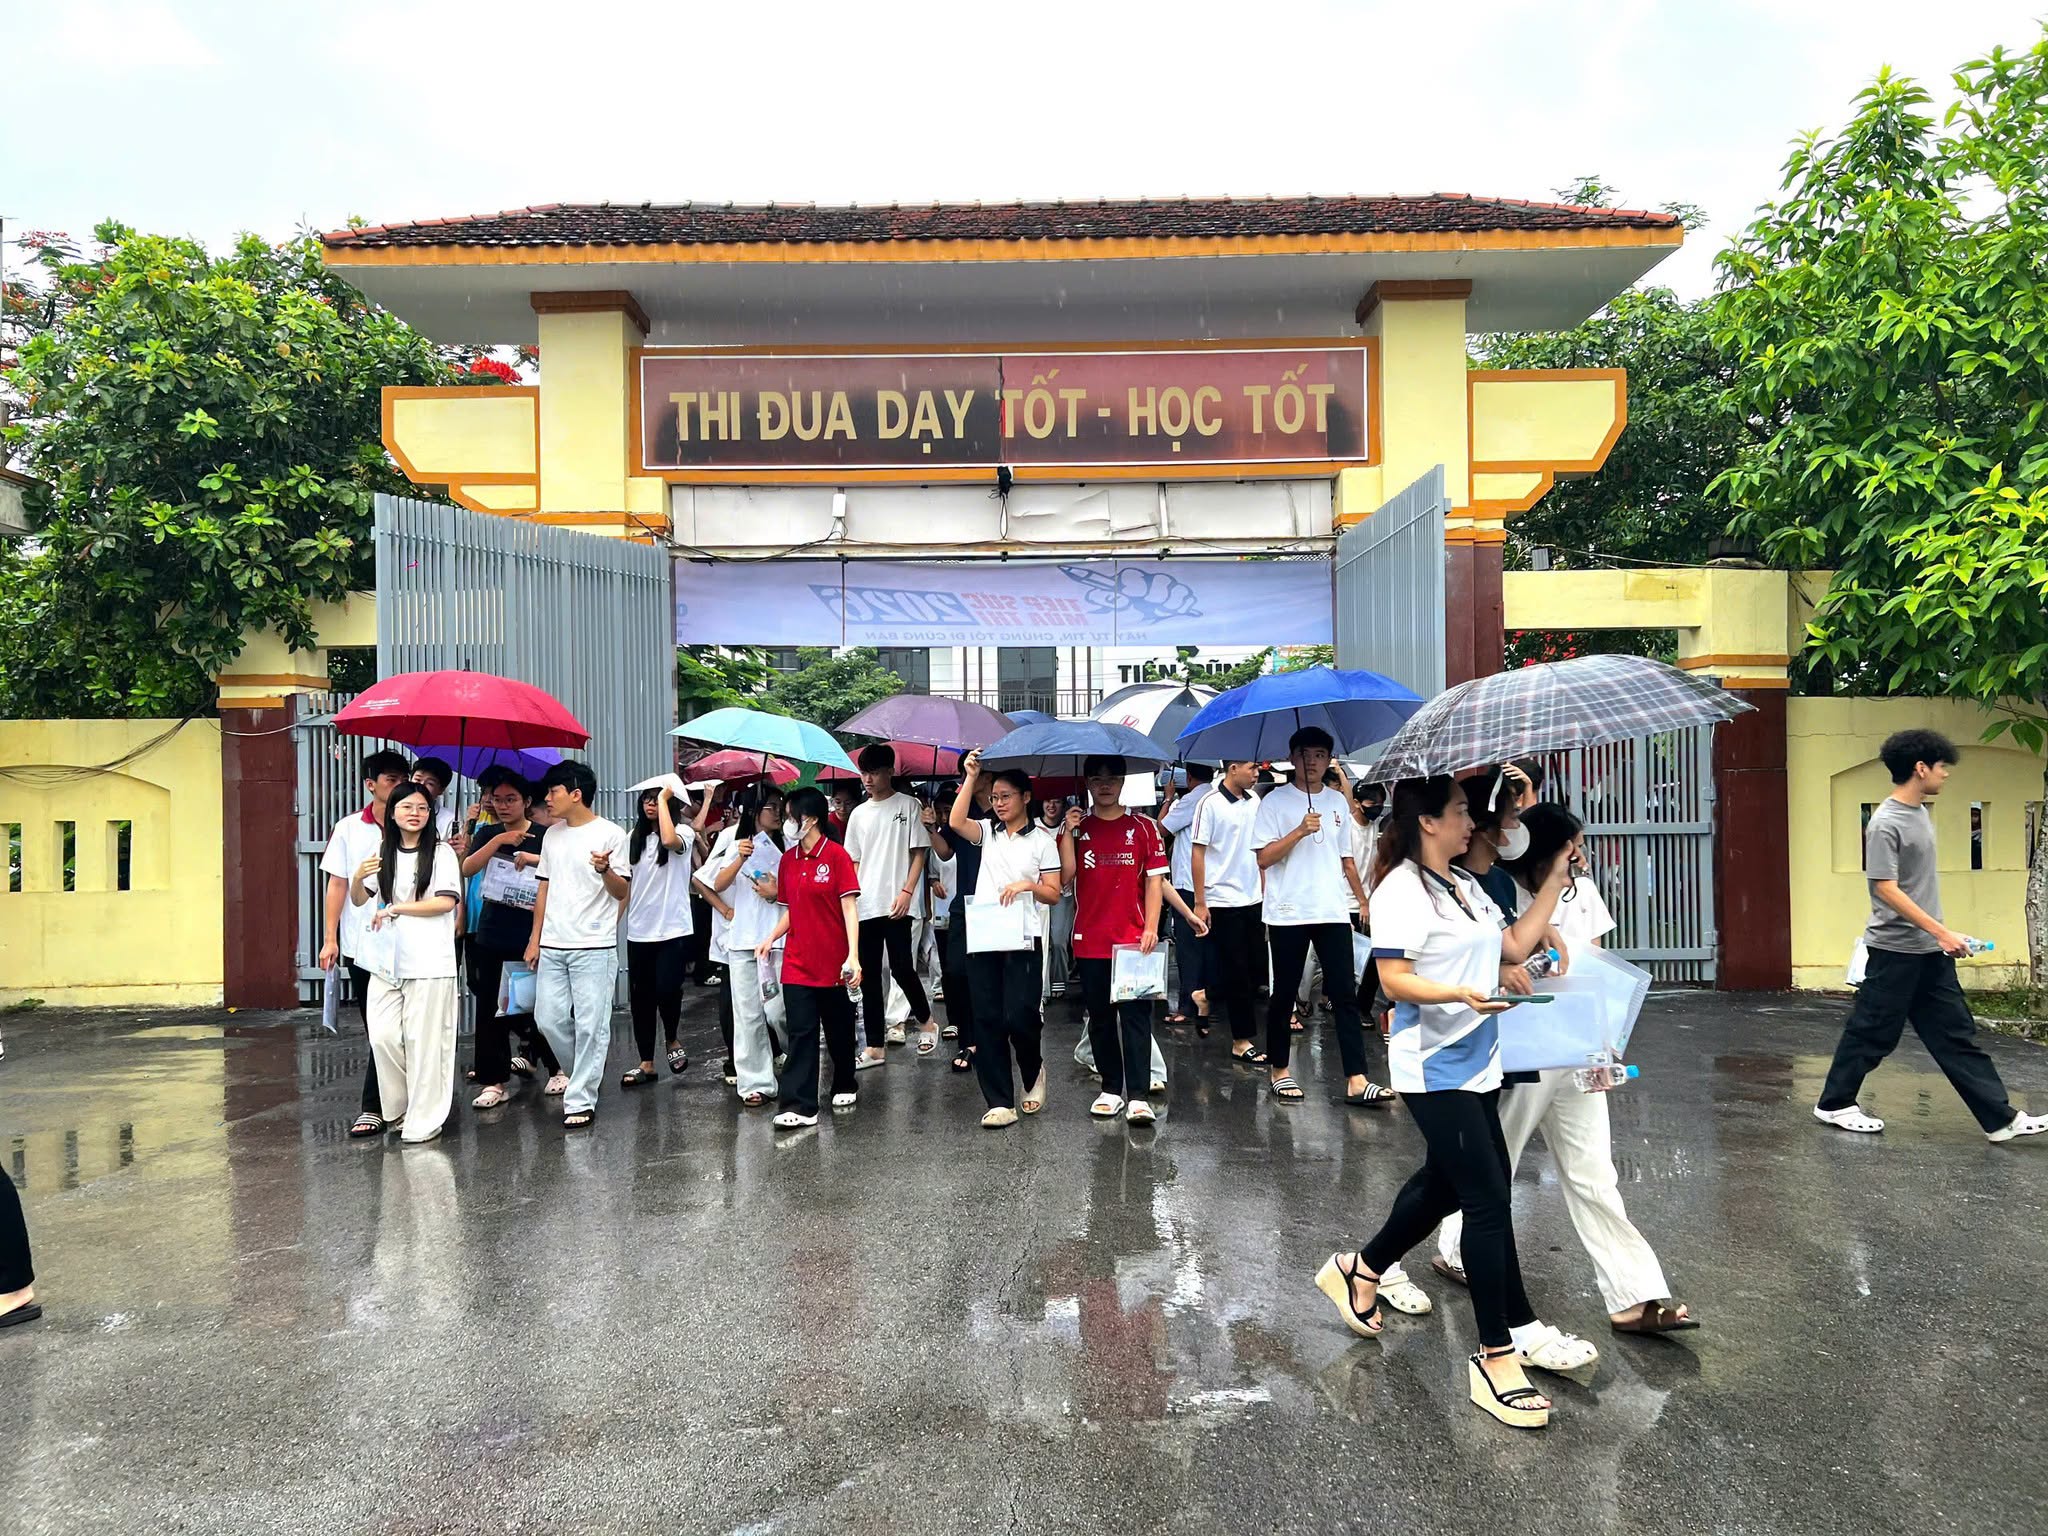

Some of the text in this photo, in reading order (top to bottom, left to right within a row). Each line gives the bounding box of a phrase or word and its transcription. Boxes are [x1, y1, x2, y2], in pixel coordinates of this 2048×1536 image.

[669, 391, 741, 441] THI
[756, 391, 857, 441] ĐUA
[877, 389, 975, 454] DẠY
[995, 368, 1087, 439] TỐT
[1128, 385, 1223, 452] HỌC
[1243, 363, 1335, 434] TỐT
[1117, 658, 1177, 683] TIẾN
